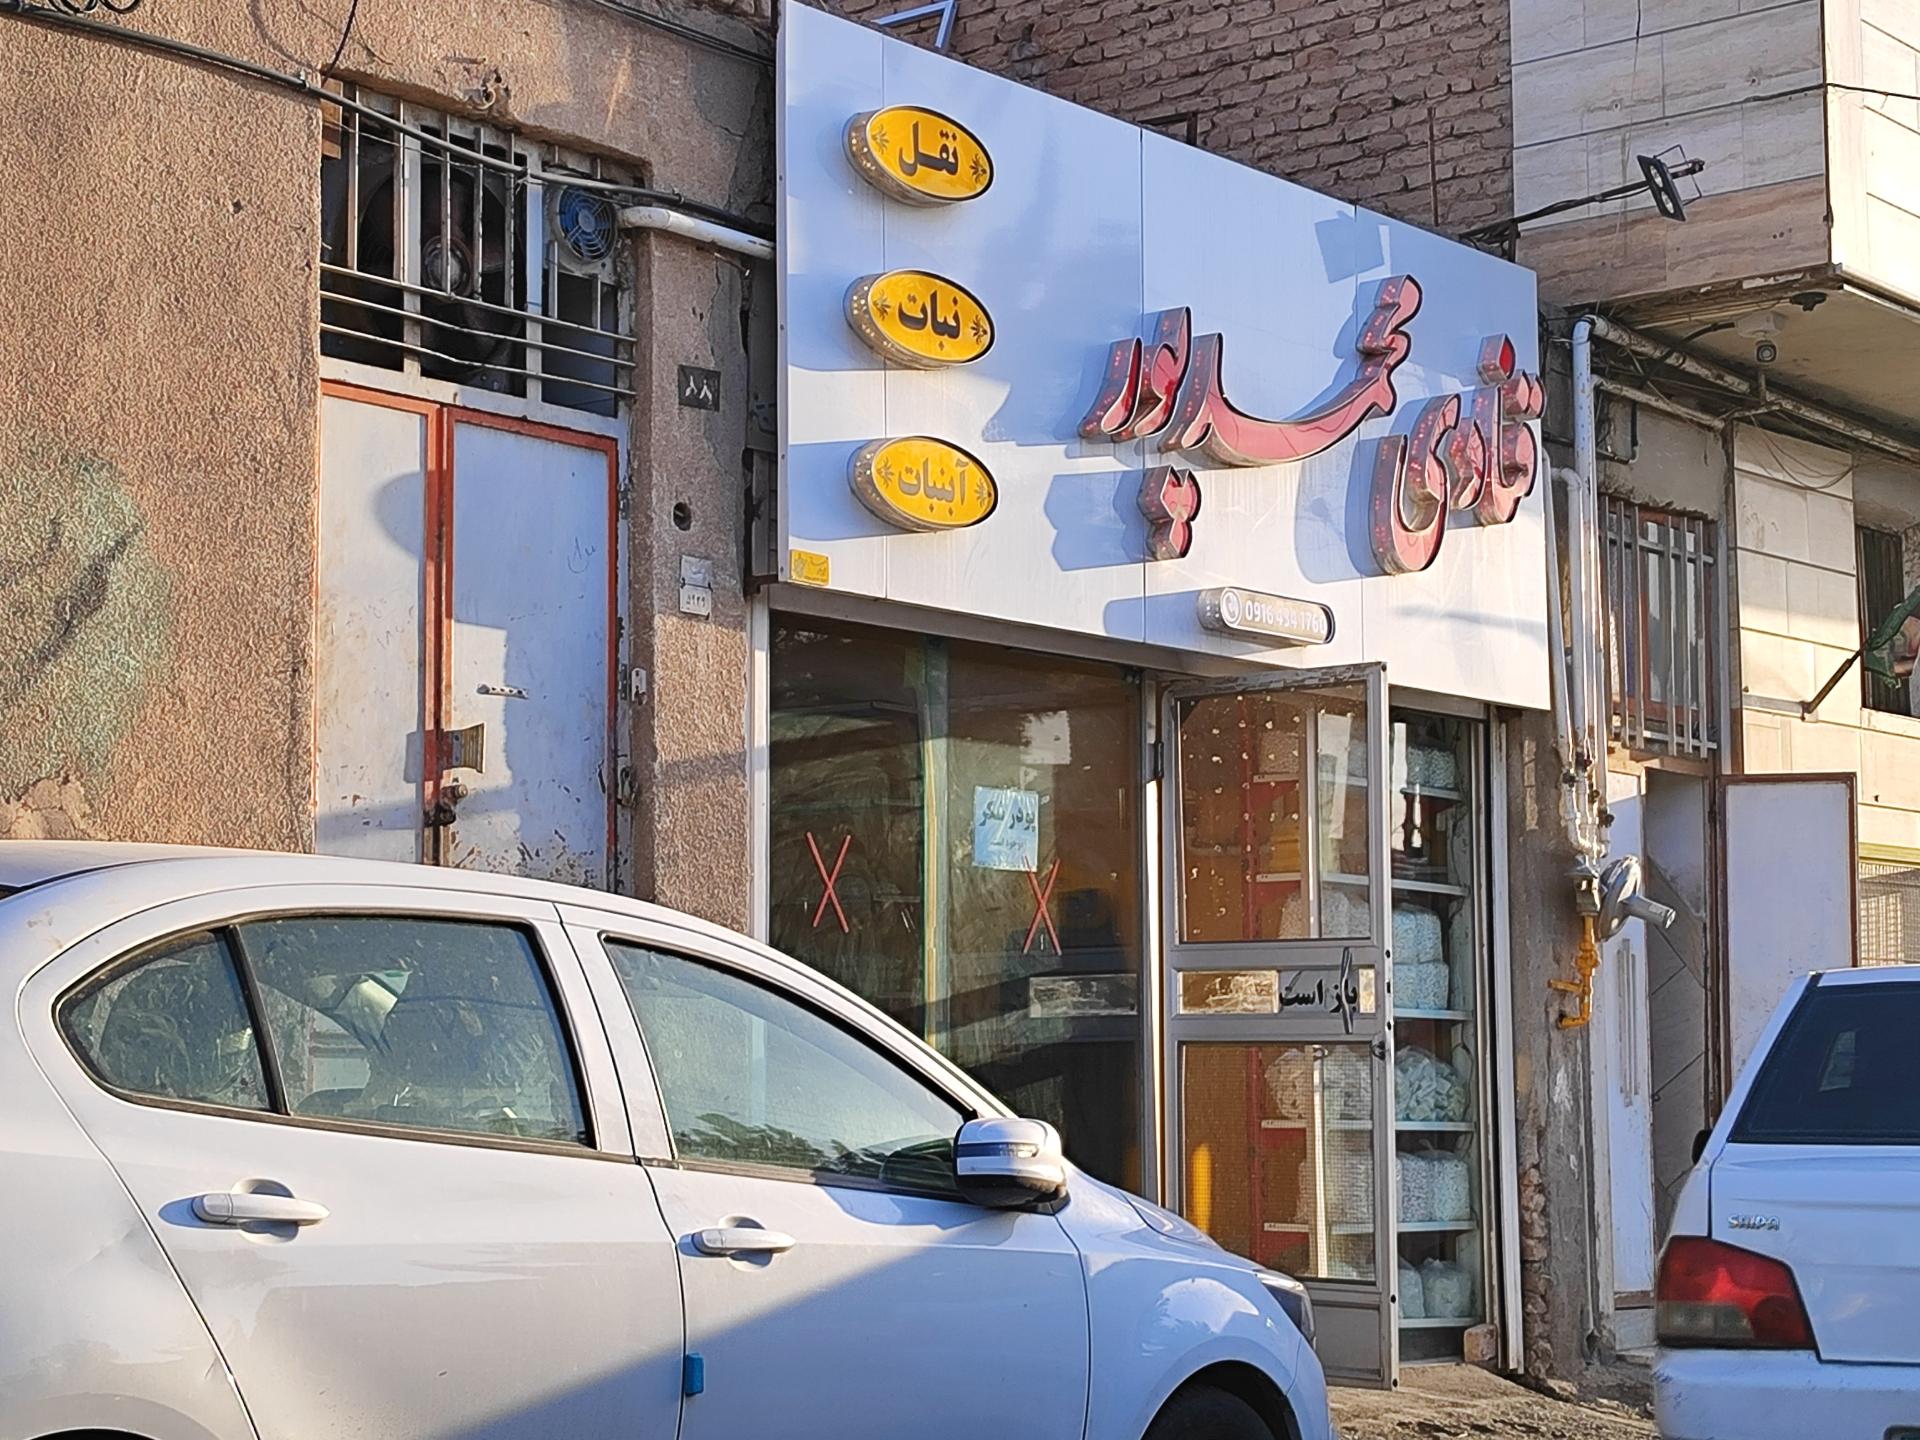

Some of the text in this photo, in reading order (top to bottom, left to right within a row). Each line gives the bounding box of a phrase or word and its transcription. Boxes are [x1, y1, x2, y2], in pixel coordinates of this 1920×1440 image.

[899, 121, 959, 177] نقل
[898, 290, 961, 351] نبات
[1374, 333, 1546, 575] قنادی
[898, 457, 970, 516] آبنبات
[1245, 600, 1274, 625] 0916
[1279, 972, 1358, 1013] باز است
